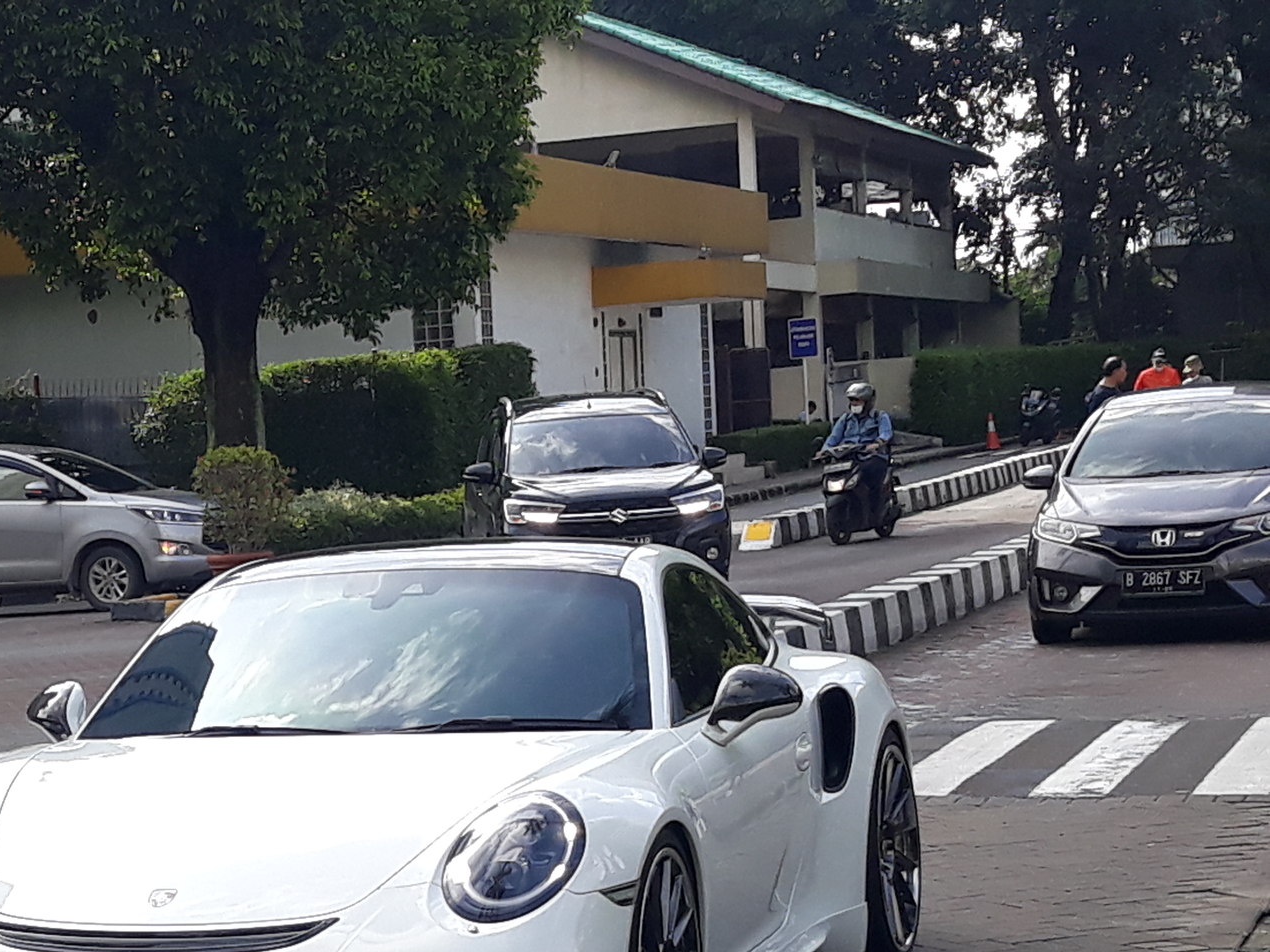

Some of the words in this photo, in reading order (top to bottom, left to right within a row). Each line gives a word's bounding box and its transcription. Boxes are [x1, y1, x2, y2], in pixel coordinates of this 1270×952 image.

[1126, 573, 1134, 586] B
[1142, 571, 1170, 586] 2867
[1178, 569, 1201, 584] SFZ
